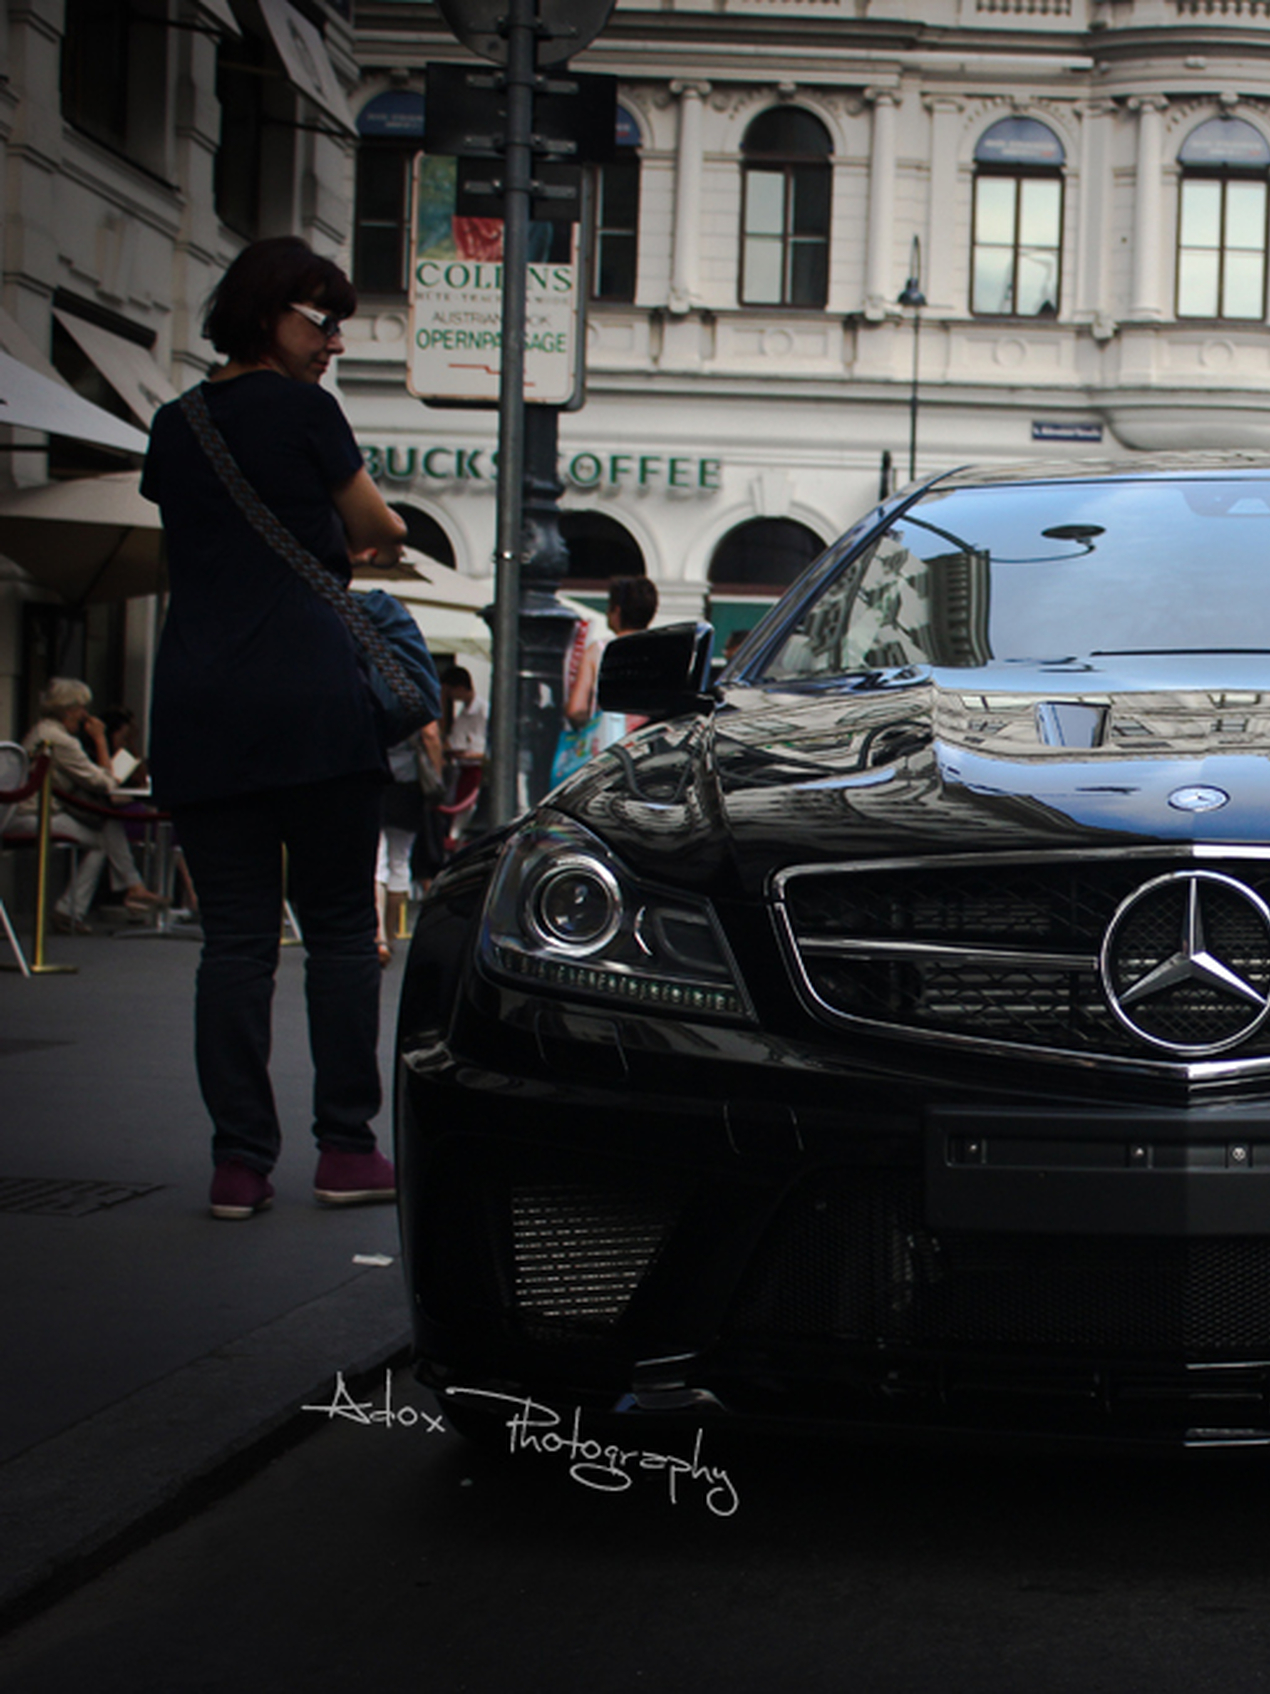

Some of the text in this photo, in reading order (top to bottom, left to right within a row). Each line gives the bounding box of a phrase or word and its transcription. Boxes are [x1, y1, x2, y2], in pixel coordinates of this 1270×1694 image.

[416, 328, 567, 354] OPERNPASAGE
[359, 446, 723, 488] BUCK OFFEE
